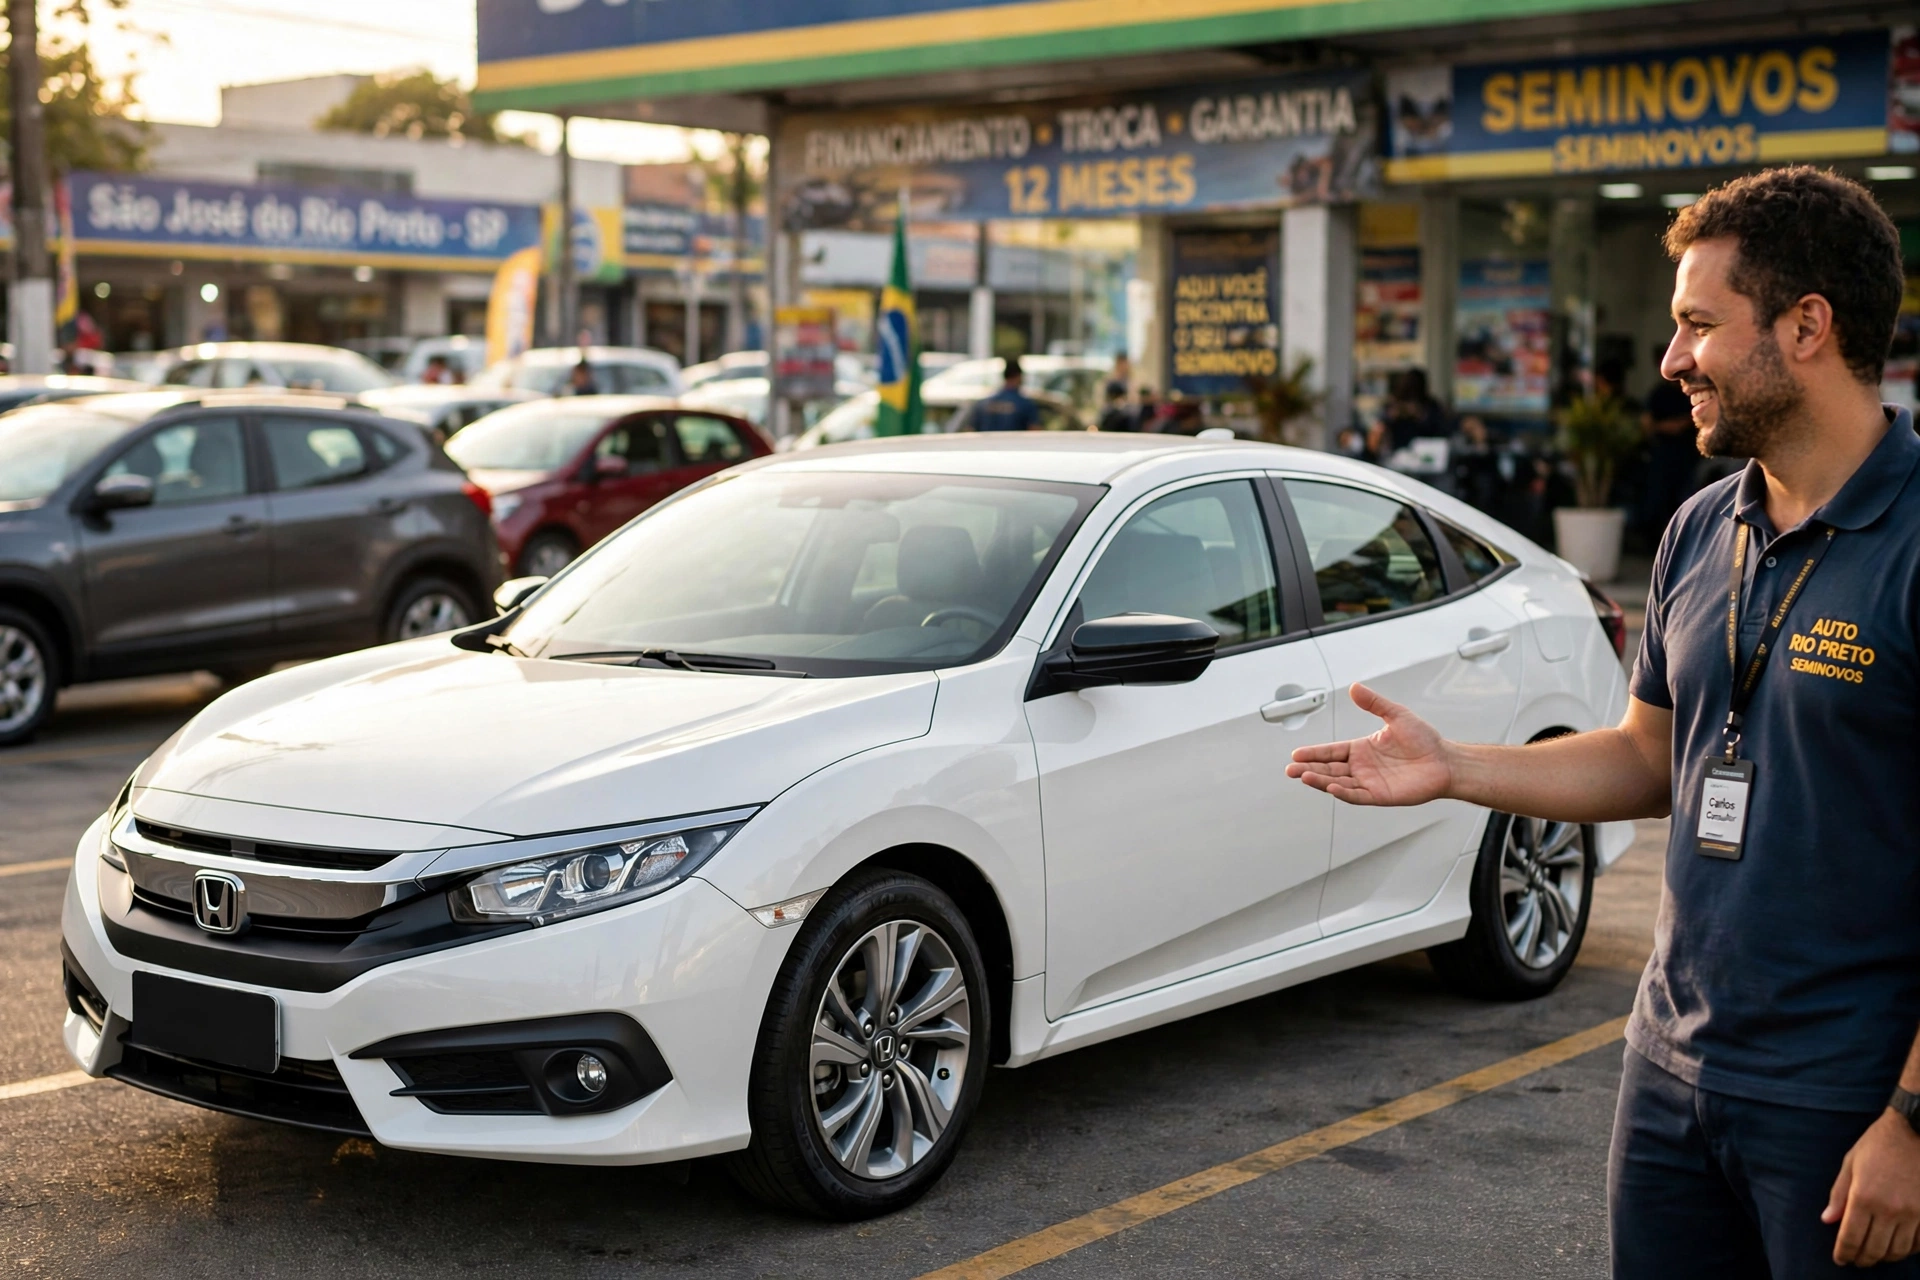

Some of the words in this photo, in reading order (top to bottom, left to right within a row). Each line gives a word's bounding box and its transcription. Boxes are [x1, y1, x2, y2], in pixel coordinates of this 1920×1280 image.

[1482, 47, 1839, 133] SEMINOVOS
[804, 115, 1032, 173] FINANCIAMENTO
[1057, 105, 1161, 151] TROCA
[1190, 88, 1356, 144] GARANTIA
[1554, 124, 1756, 171] SEMINOVOS
[1005, 165, 1049, 214] 12
[1058, 154, 1197, 211] MESES
[88, 182, 162, 231] São
[164, 187, 248, 238] José
[252, 192, 298, 240] do
[301, 196, 357, 244] Rio
[359, 198, 445, 248] Preto
[464, 207, 509, 249] SP
[1174, 349, 1277, 376] SEMINOVO
[1788, 633, 1817, 654] RIO
[1817, 639, 1876, 666] PRETO
[1810, 618, 1859, 641] AUTO
[1790, 657, 1864, 684] SEMINOVOS
[1708, 797, 1736, 811] Carlos
